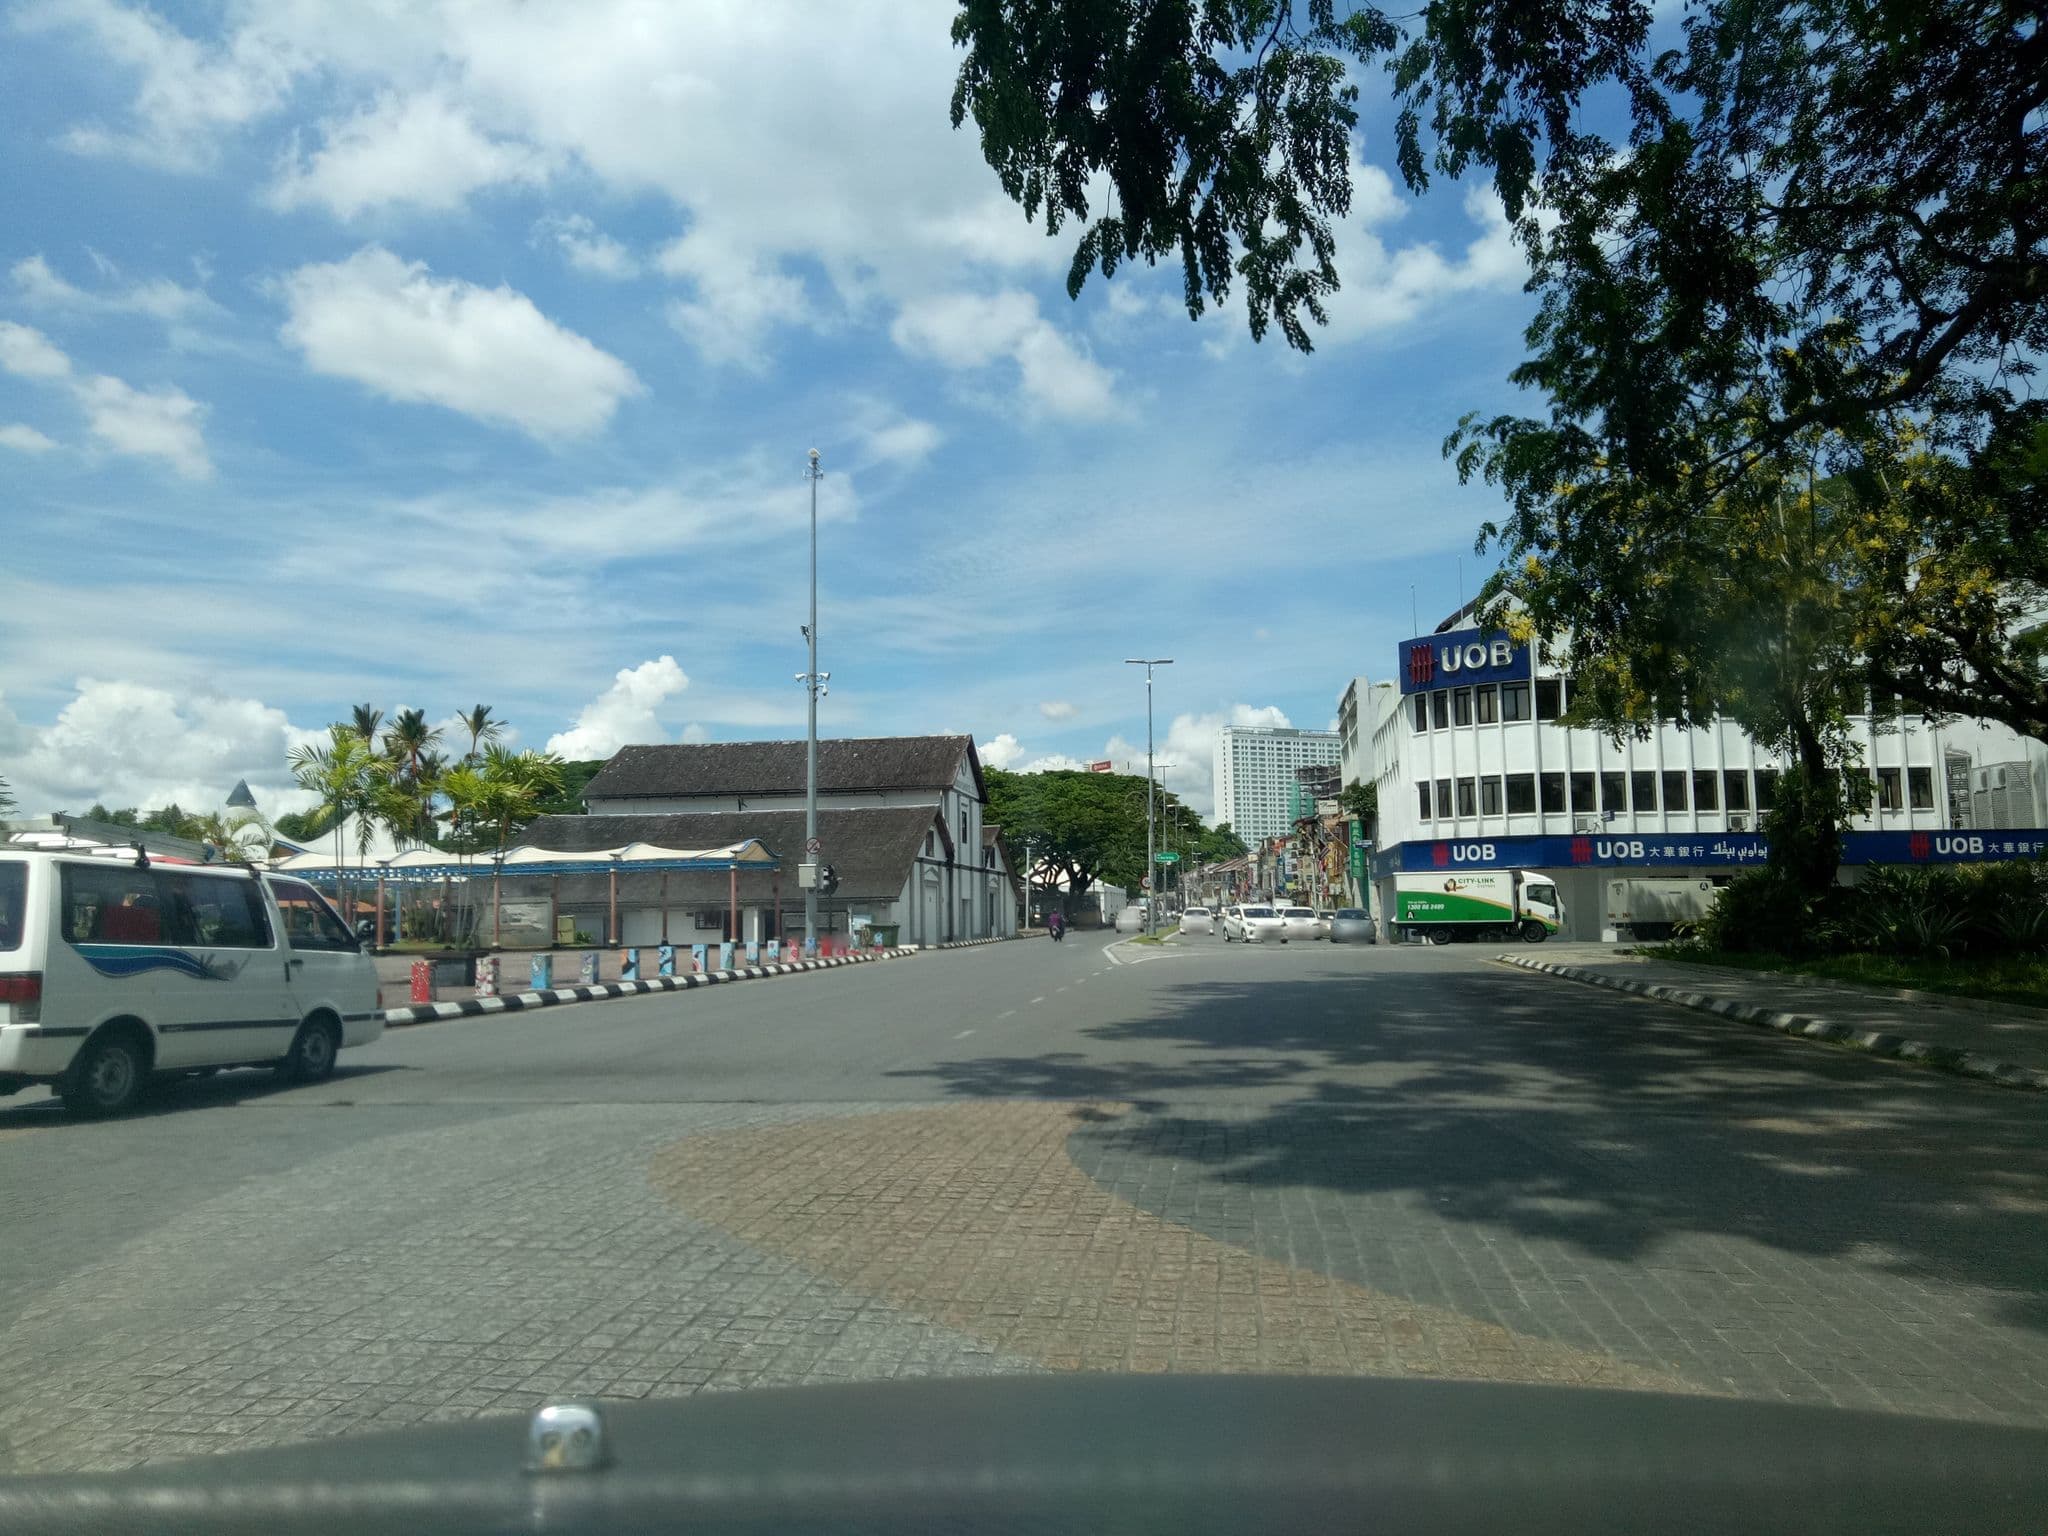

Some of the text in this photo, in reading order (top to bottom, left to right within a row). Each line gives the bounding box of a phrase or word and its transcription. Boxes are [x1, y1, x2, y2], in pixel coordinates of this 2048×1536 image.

[1441, 640, 1513, 672] UOB
[1453, 844, 1497, 862] UOB
[1597, 841, 1645, 859] UOB
[1650, 846, 1705, 858] 大華銀行
[1936, 837, 1984, 854] UOB
[1988, 842, 2045, 853] 大華銀行
[1407, 911, 1414, 919] A
